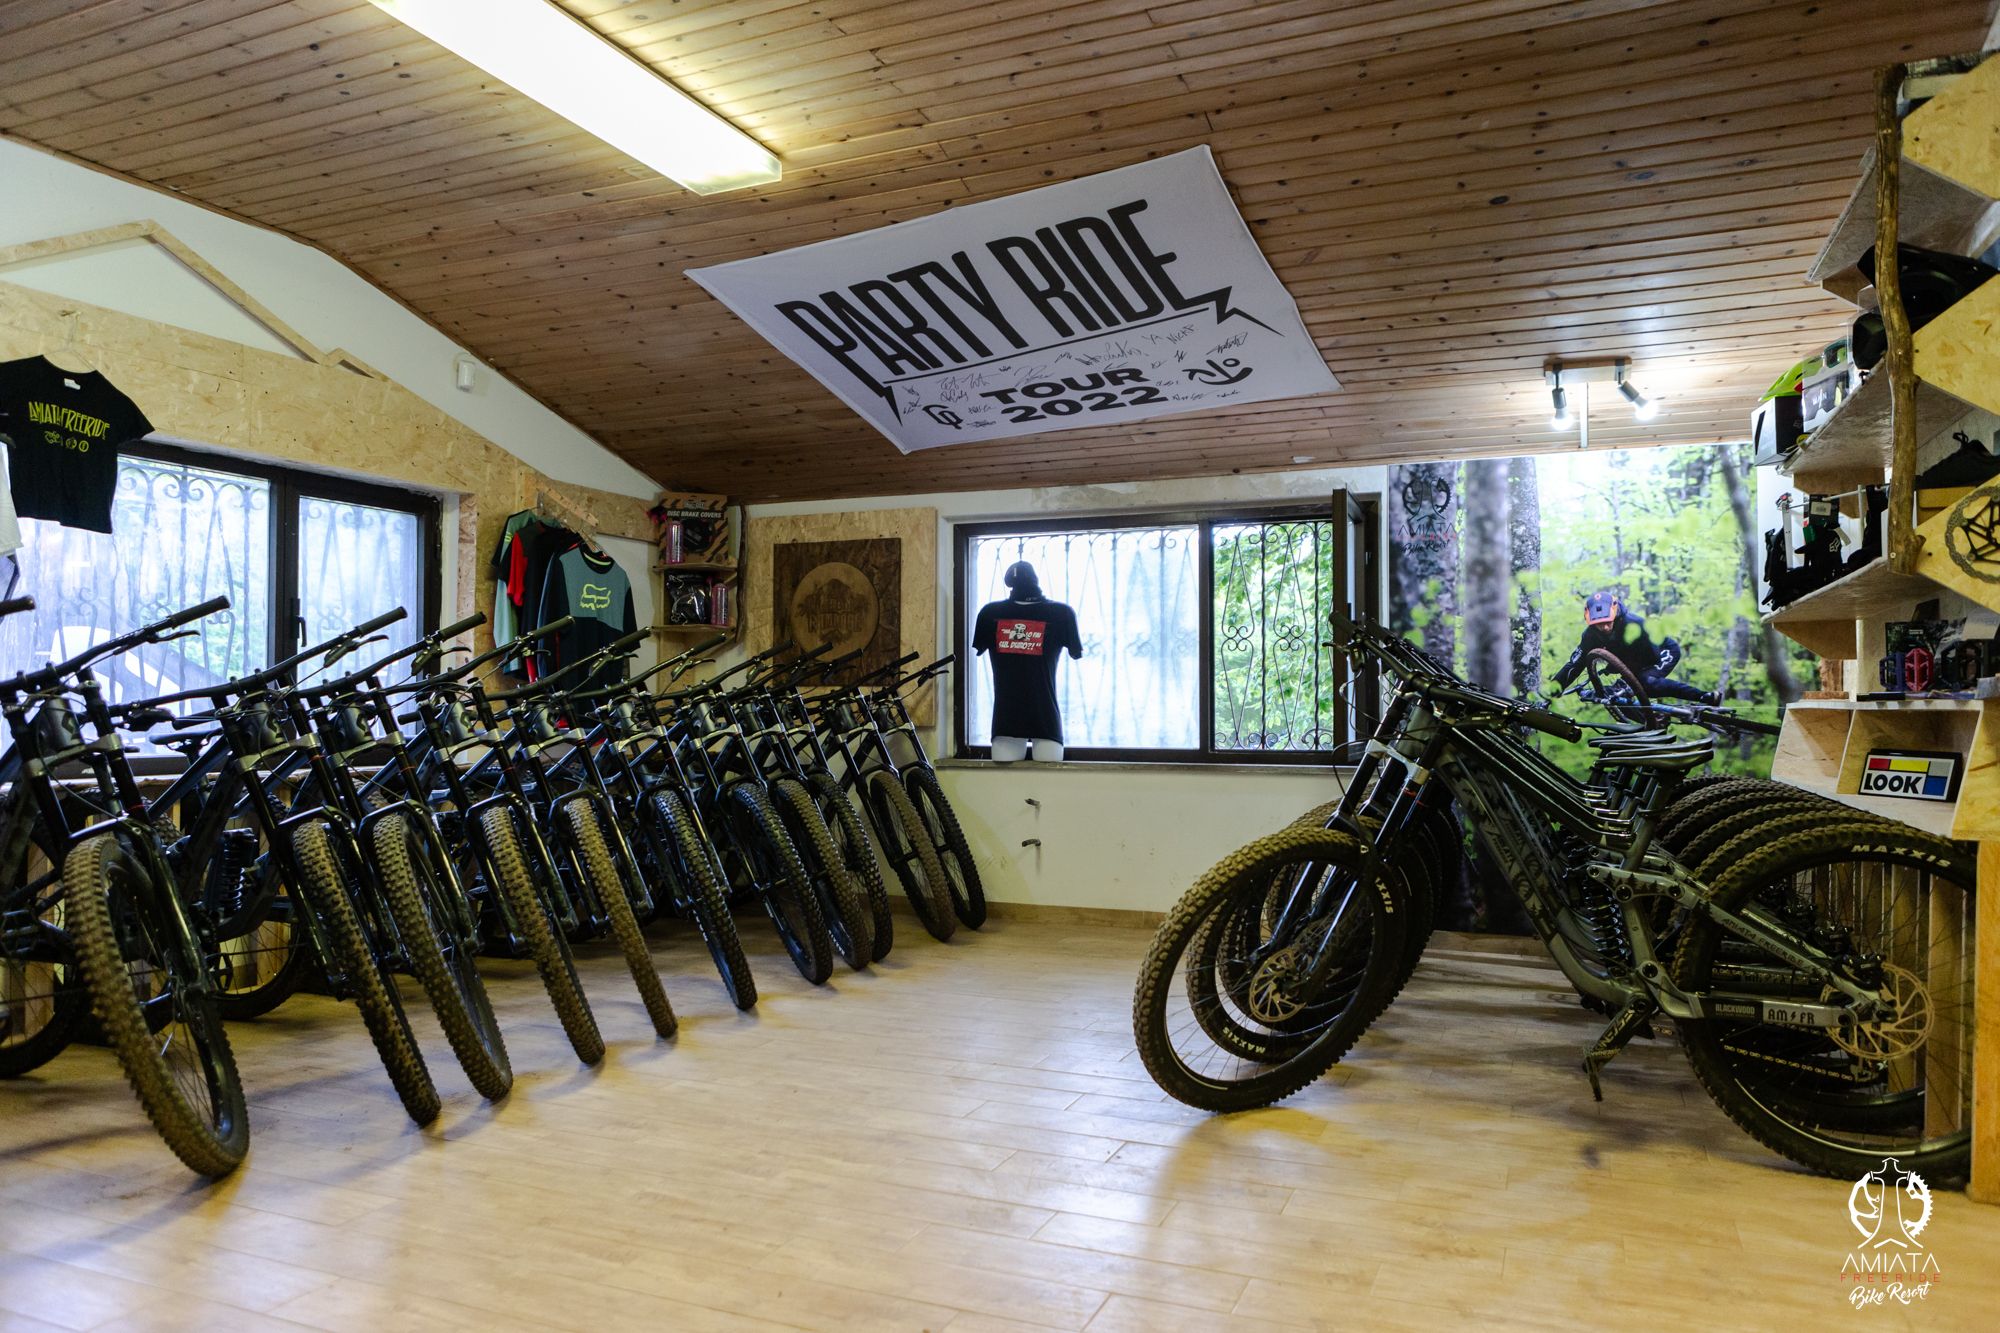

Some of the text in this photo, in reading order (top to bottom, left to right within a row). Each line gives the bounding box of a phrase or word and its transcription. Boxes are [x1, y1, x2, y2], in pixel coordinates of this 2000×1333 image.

[775, 199, 1214, 398] PARTY RIDE
[979, 367, 1151, 405] TOUR
[1001, 386, 1168, 424] 2022
[700, 511, 721, 519] COVERS
[1864, 773, 1922, 794] LOOK
[1851, 845, 1951, 867] MAXXIS
[1715, 1003, 1815, 1024] BLACKWOOD AM FR
[1222, 1026, 1266, 1054] MAXXIS
